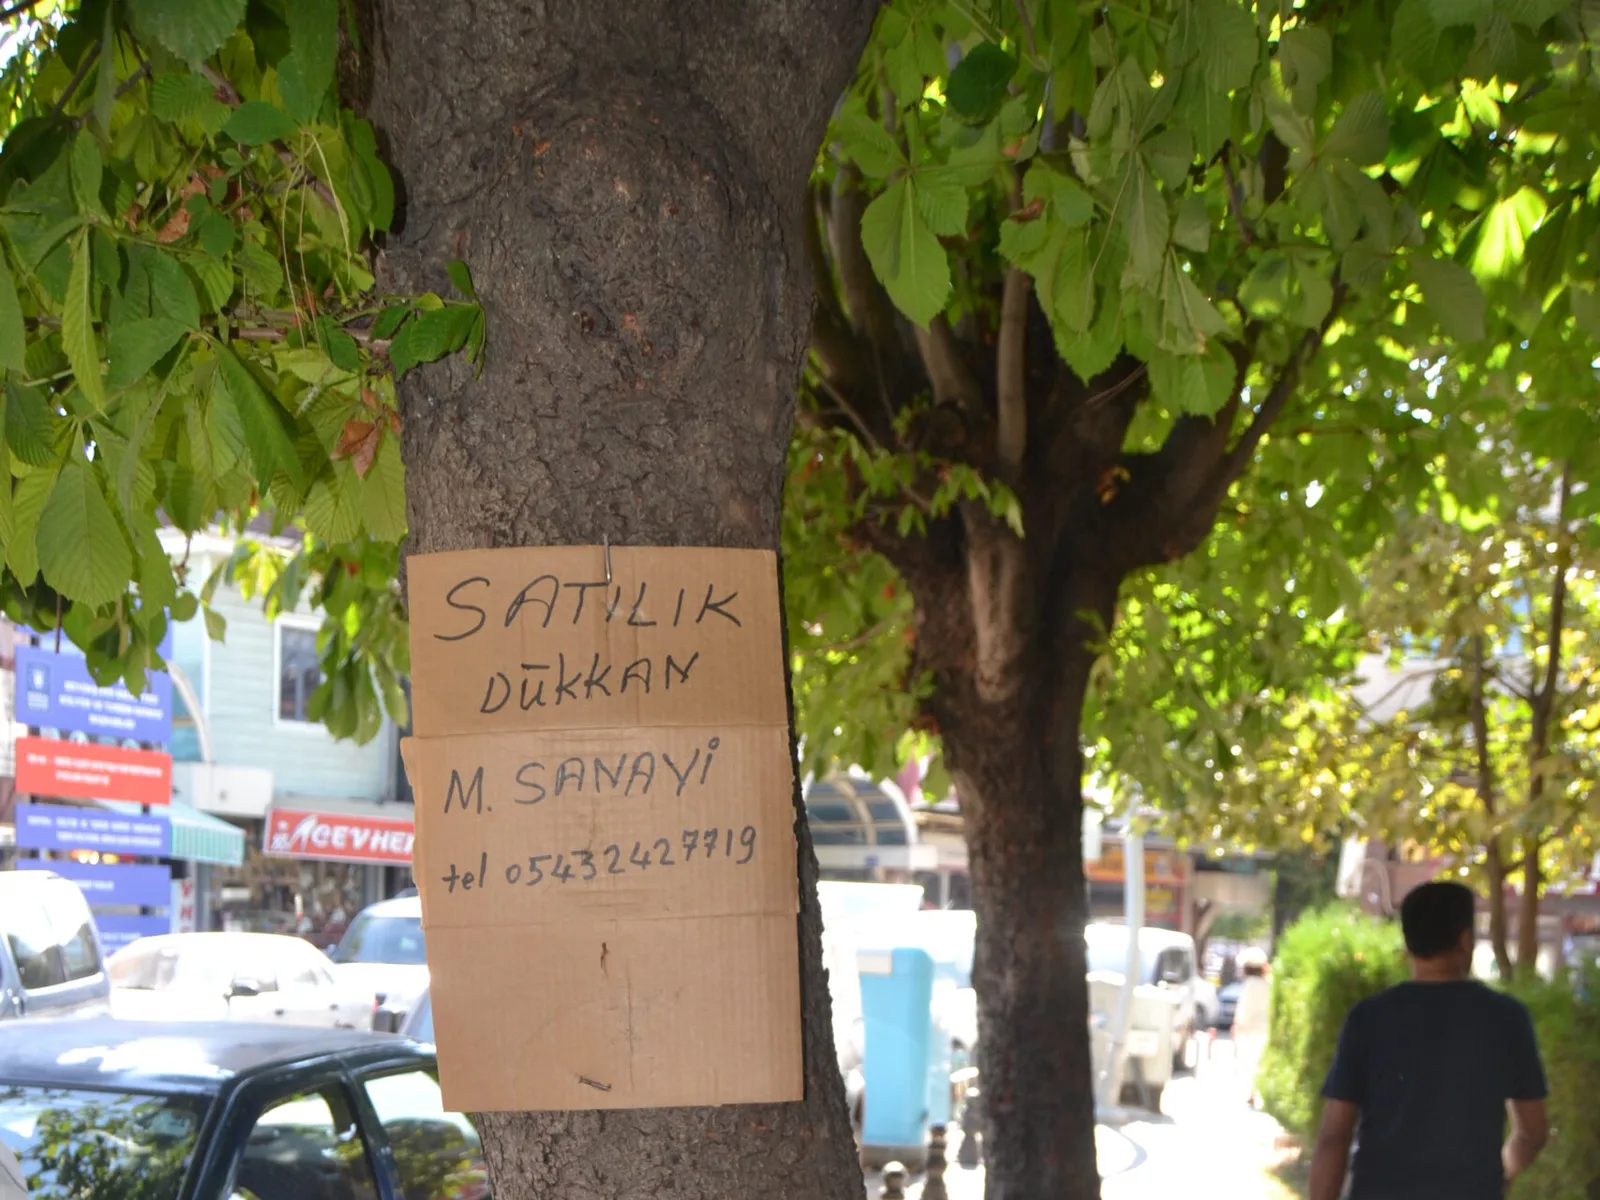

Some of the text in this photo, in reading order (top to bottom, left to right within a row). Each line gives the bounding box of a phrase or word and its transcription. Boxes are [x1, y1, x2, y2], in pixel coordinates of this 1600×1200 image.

[434, 575, 742, 640] SATILIK
[443, 766, 493, 814] M.
[442, 826, 757, 893] tel 05432427719
